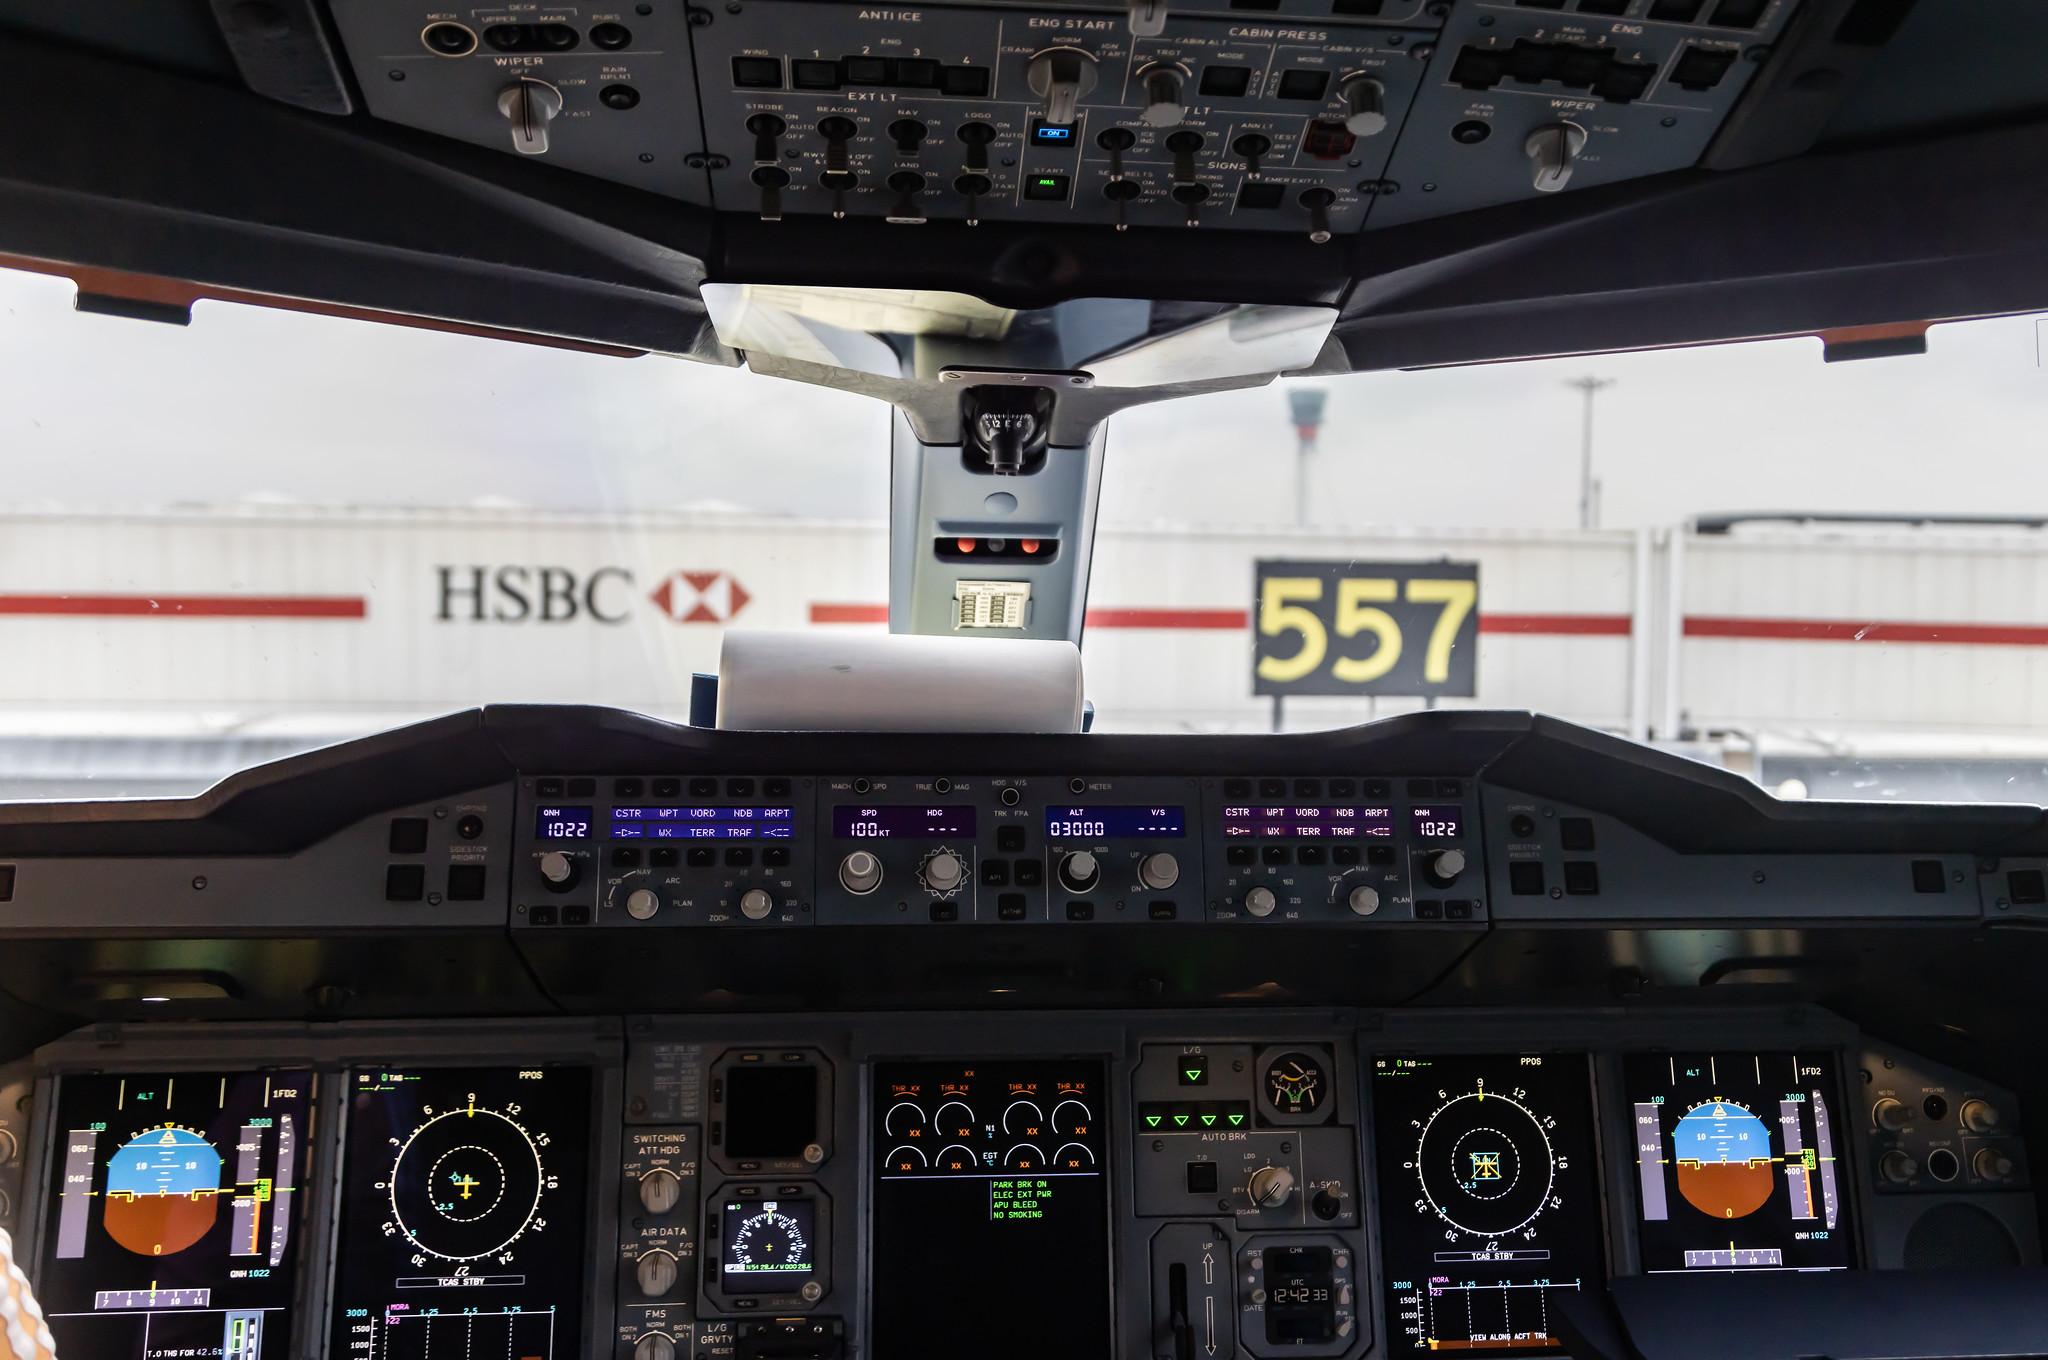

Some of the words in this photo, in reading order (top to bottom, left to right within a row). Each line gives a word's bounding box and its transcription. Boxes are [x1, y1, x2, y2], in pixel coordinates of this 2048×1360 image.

[859, 10, 894, 21] ANTI
[898, 12, 922, 22] ICE
[1029, 18, 1060, 28] ENG
[1065, 19, 1115, 30] START
[1611, 24, 1643, 35] ENG
[1229, 27, 1274, 38] CABIN
[1277, 30, 1328, 41] PRESS
[862, 46, 870, 54] 2
[913, 48, 920, 56] 3
[495, 57, 544, 66] WIPER
[962, 56, 970, 64] 4
[848, 92, 874, 101] EXT
[880, 92, 896, 102] LT
[1551, 99, 1595, 111] WIPER
[816, 106, 858, 114] BEACON
[1207, 162, 1247, 170] SIGNS
[435, 566, 635, 624] HSBC
[1258, 577, 1477, 682] 557
[616, 809, 642, 818] CSTR
[660, 809, 678, 818] WPT
[690, 809, 716, 818] VORD
[734, 809, 752, 818] NDB
[764, 809, 790, 818] ARPT
[1226, 808, 1250, 816] CSTR
[1267, 808, 1284, 816] WPT
[1296, 808, 1320, 816] VORD
[1336, 808, 1354, 816] NDB
[1365, 808, 1388, 817] ARPT
[548, 822, 587, 836] 1022
[659, 828, 672, 836] WX
[690, 828, 715, 836] TERR
[728, 828, 752, 836] TRAF
[1051, 822, 1104, 836] 03000
[1268, 827, 1280, 836] WX
[1297, 827, 1320, 836] TERR
[1332, 827, 1355, 836] TRAF
[1421, 822, 1456, 836] 1022
[666, 876, 680, 884] ARC
[1520, 1058, 1541, 1066] PPOS
[519, 1071, 543, 1079] PPOS
[1801, 1068, 1821, 1076] 1FD2
[1477, 1078, 1484, 1086] 9
[137, 1092, 154, 1100] ALT
[273, 1089, 297, 1099] 1FD2
[1438, 1090, 1447, 1098] 6
[1512, 1087, 1526, 1099] 12
[468, 1093, 476, 1102] 9
[505, 1102, 522, 1115] 12
[1543, 1115, 1556, 1129] 15
[910, 1129, 921, 1137] XX
[1075, 1127, 1087, 1135] XX
[535, 1132, 551, 1147] 15
[633, 1135, 686, 1143] SWITCHING
[1201, 1133, 1226, 1141] AUTO
[1228, 1132, 1247, 1141] BRK
[639, 1147, 657, 1155] ATT
[661, 1146, 681, 1155] HDG
[983, 1152, 998, 1160] EGT
[1558, 1156, 1568, 1169] 18
[993, 1181, 1014, 1189] PARK
[993, 1211, 1004, 1219] NO
[641, 1228, 658, 1236] AIR
[661, 1228, 687, 1236] DATA
[248, 1269, 270, 1277] 1022
[438, 1278, 460, 1286] TCAS
[463, 1278, 485, 1286] STBY
[421, 1308, 439, 1316] 1.25
[646, 1310, 666, 1318] FMS
[708, 1324, 727, 1332] L/G
[701, 1335, 734, 1344] GRVTY
